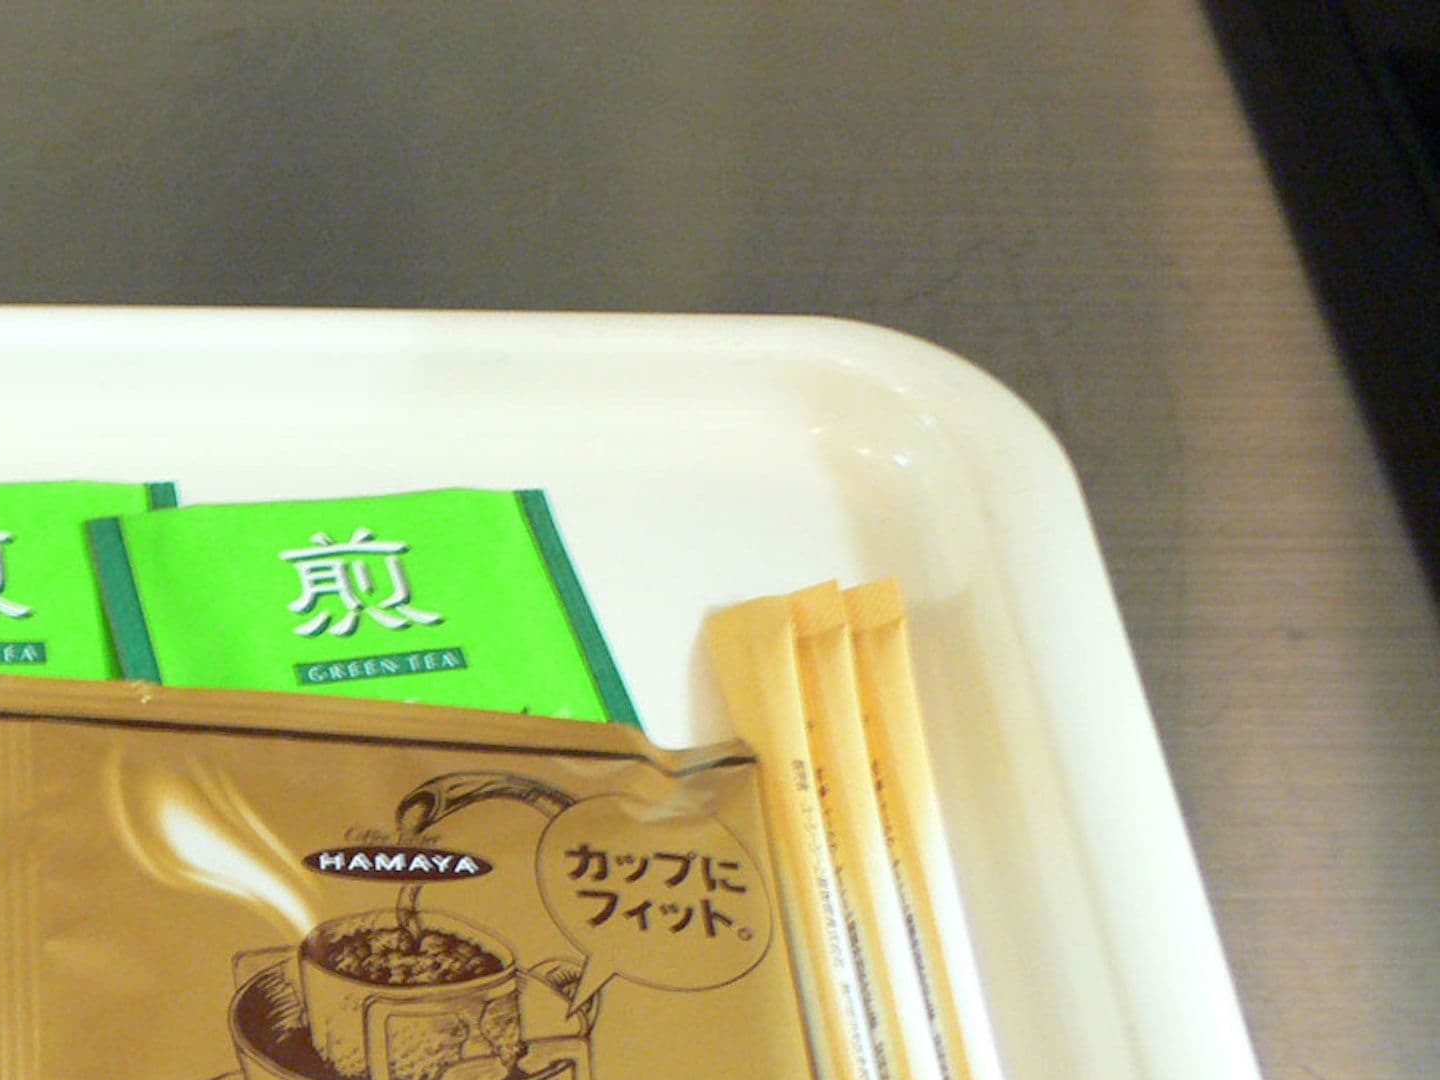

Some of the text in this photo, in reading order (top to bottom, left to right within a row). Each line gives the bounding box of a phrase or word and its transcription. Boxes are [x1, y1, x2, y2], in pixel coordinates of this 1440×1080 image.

[278, 526, 447, 636] 煎
[306, 649, 462, 684] GREEN TEA
[318, 851, 480, 874] HAMAYA
[564, 843, 747, 894] カップに
[575, 888, 756, 942] フィット。
